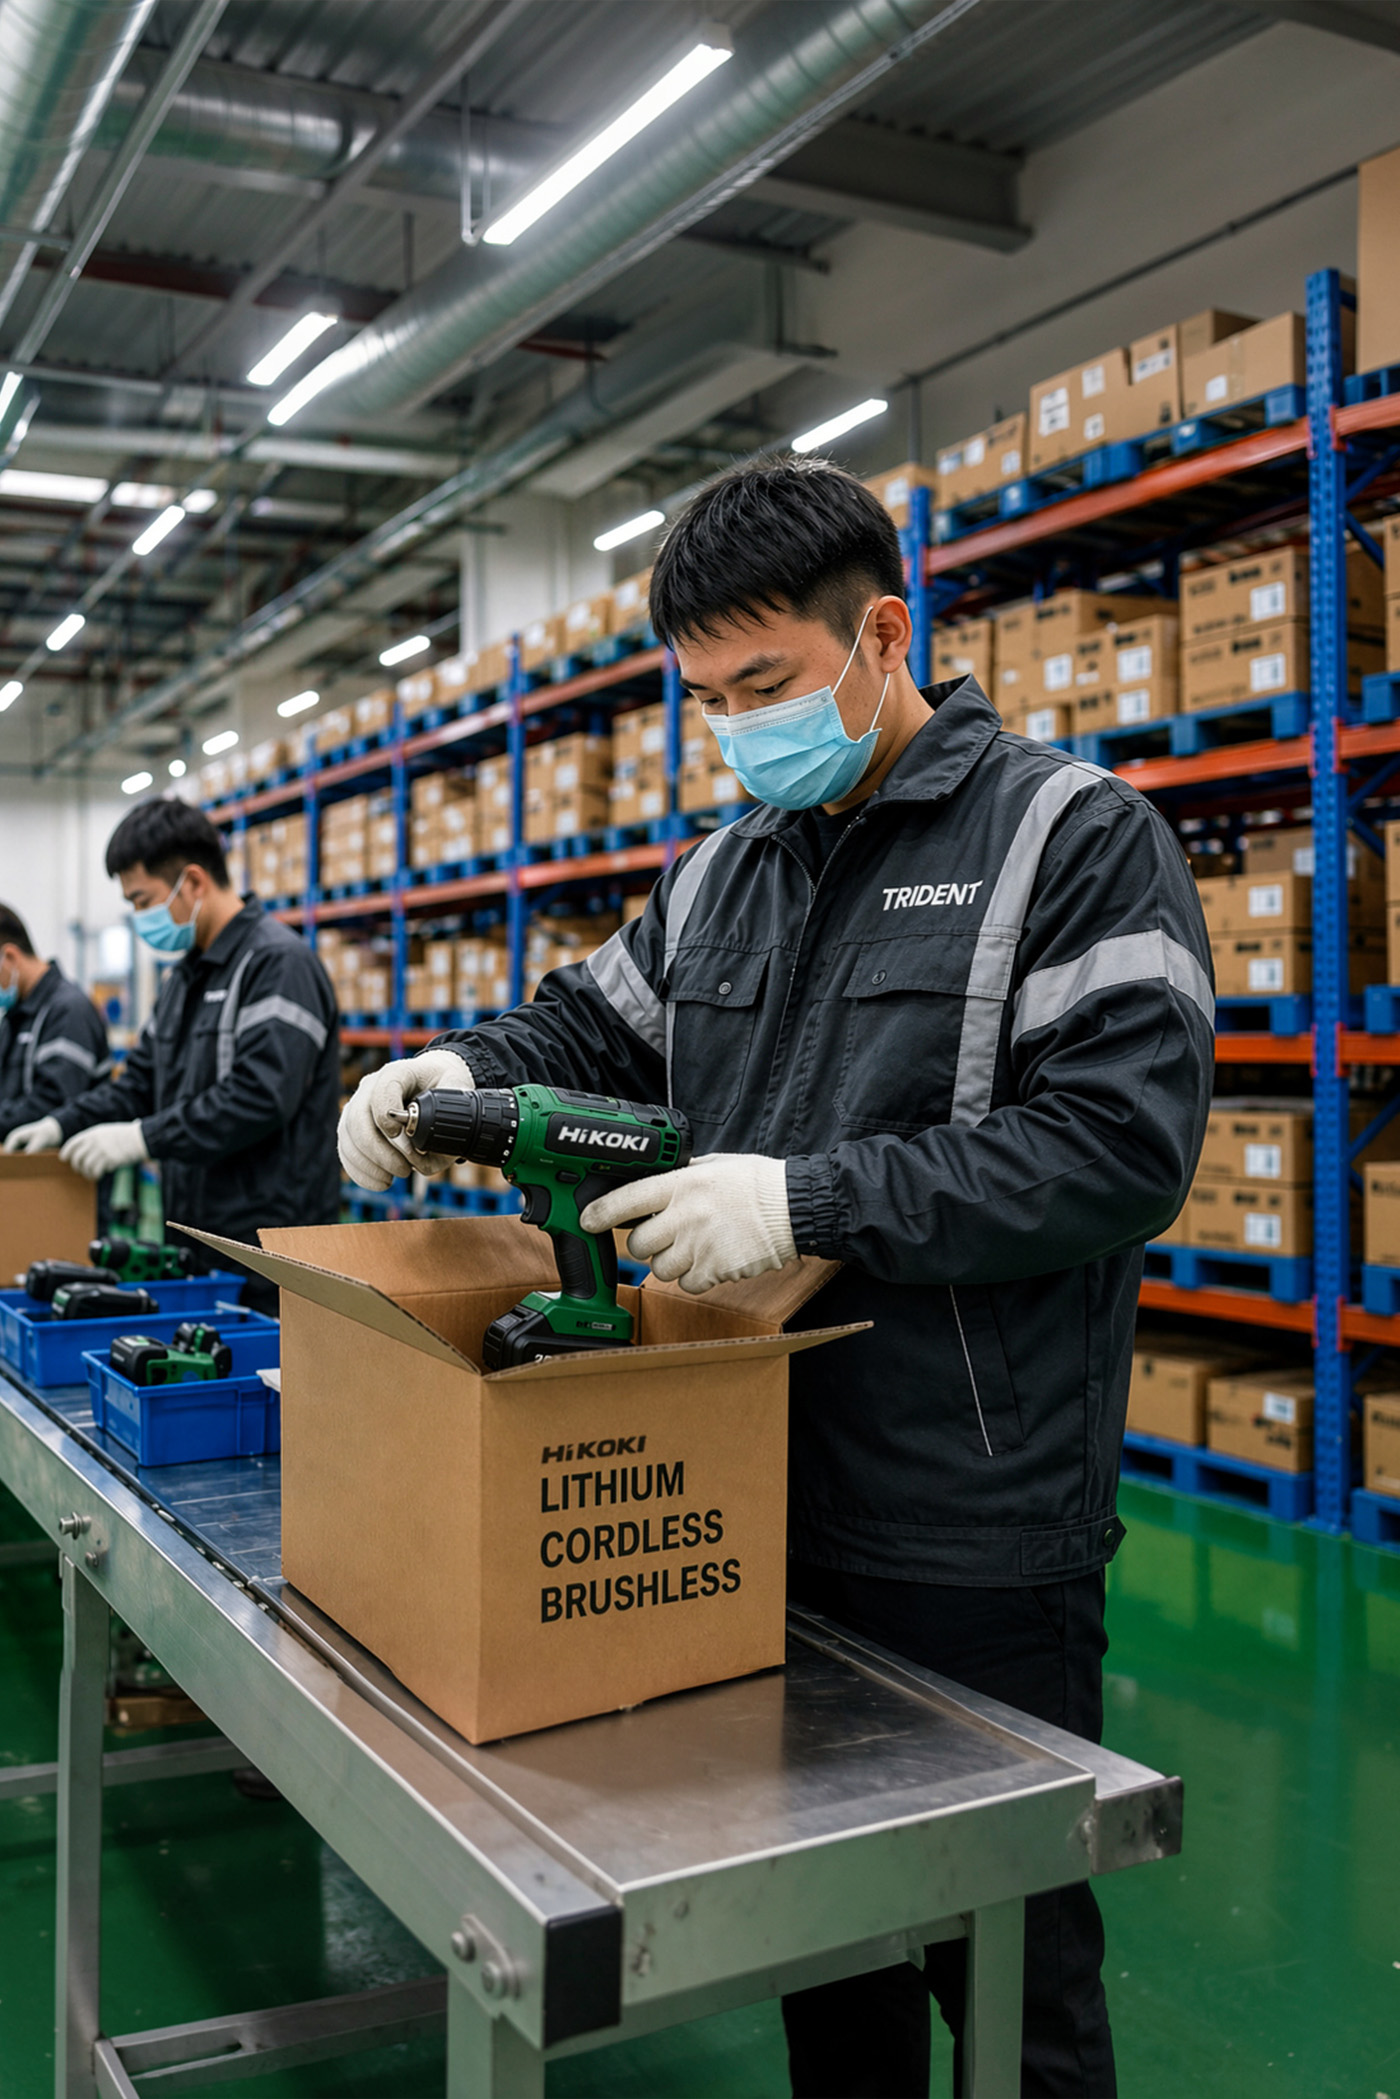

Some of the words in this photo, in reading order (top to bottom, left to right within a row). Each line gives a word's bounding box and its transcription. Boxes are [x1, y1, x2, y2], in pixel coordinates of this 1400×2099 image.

[882, 879, 984, 912] TRIDENT
[558, 1126, 650, 1153] HiKOKI
[541, 1435, 647, 1464] HiKOKI
[541, 1460, 684, 1513] LITHIUM
[540, 1508, 724, 1568] CORDLESS
[541, 1558, 741, 1623] BRUSHLESS
